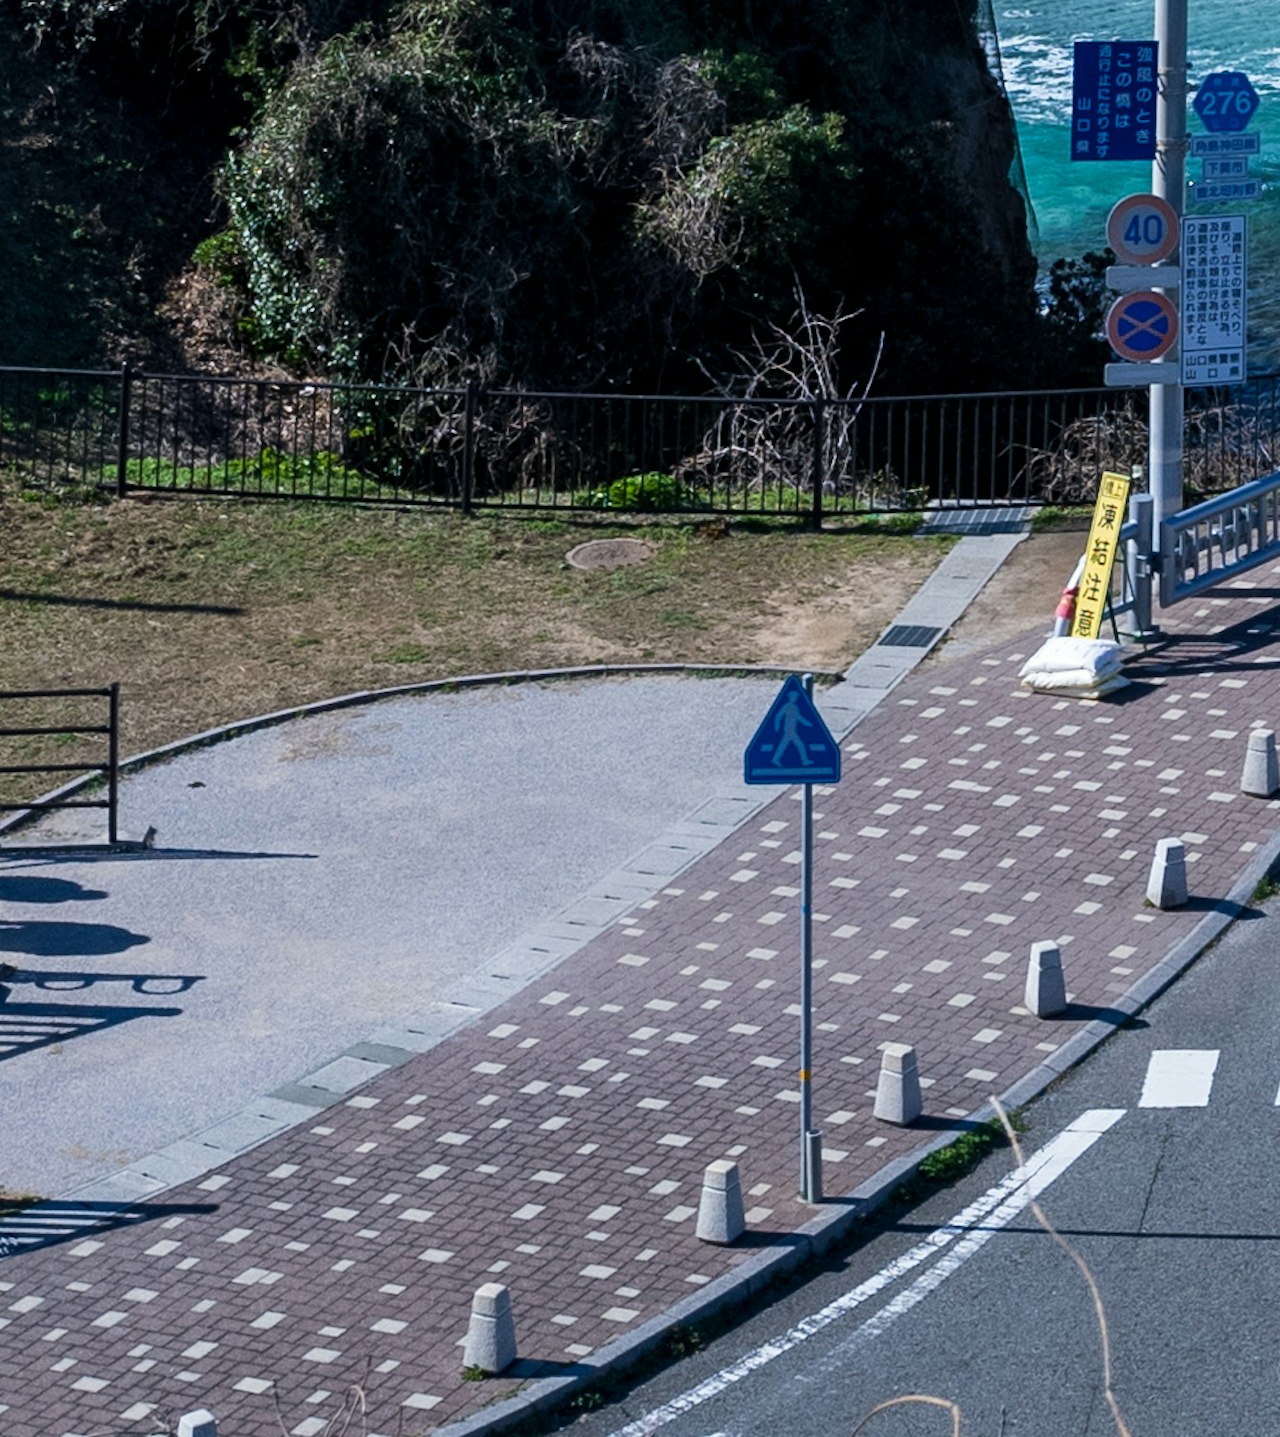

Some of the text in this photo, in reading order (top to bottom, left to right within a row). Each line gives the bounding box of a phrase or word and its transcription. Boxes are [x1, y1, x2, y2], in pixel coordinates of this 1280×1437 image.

[1076, 97, 1091, 153] 山口県
[1096, 44, 1112, 158] 通行止になります
[1115, 52, 1132, 128] この橋は
[1136, 47, 1153, 144] 強風のとき
[1202, 90, 1251, 115] 276
[1123, 214, 1163, 246] 40
[1075, 502, 1118, 637] 凍結注意
